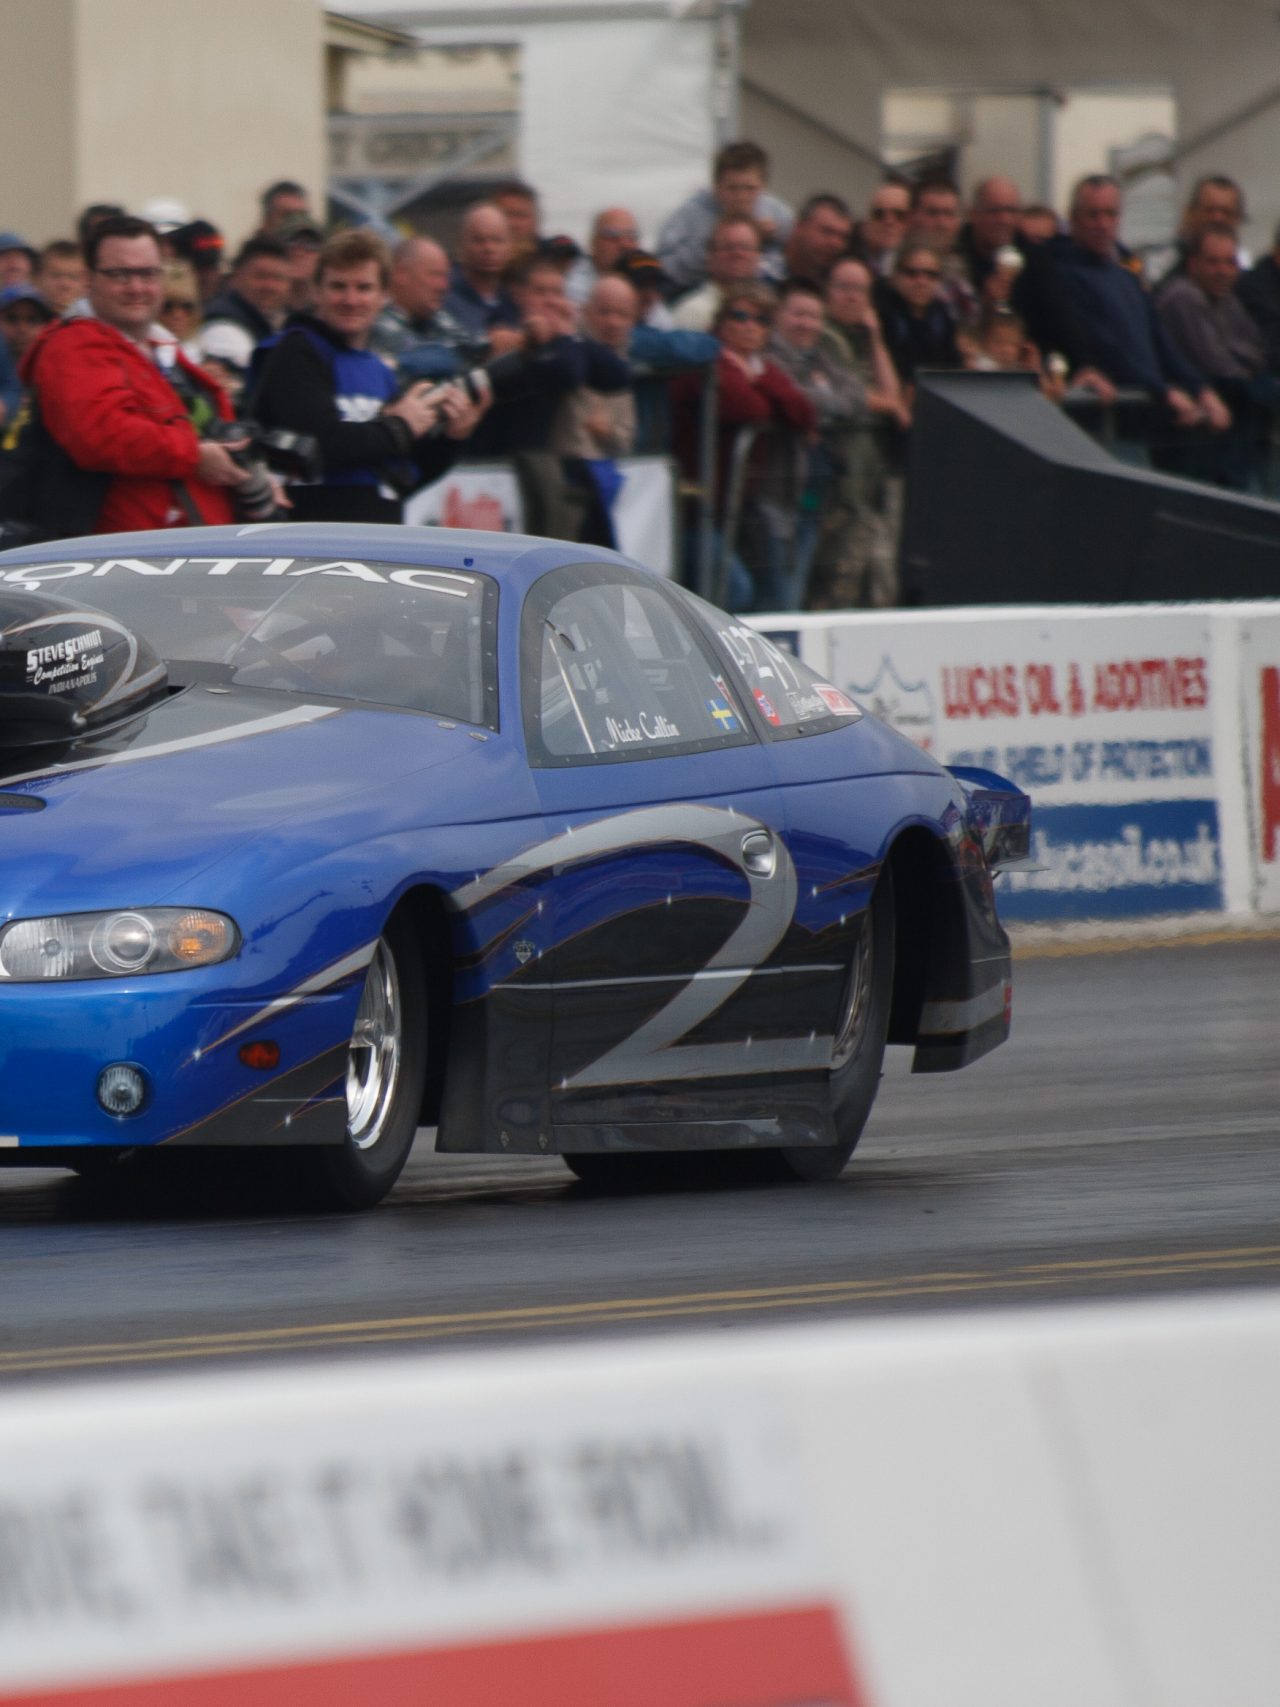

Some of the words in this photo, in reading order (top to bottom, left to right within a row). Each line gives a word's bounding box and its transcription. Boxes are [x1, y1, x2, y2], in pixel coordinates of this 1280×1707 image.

[941, 662, 1019, 719] LUCAS
[1025, 662, 1061, 717] OIL
[1093, 656, 1208, 713] ADDITIVES
